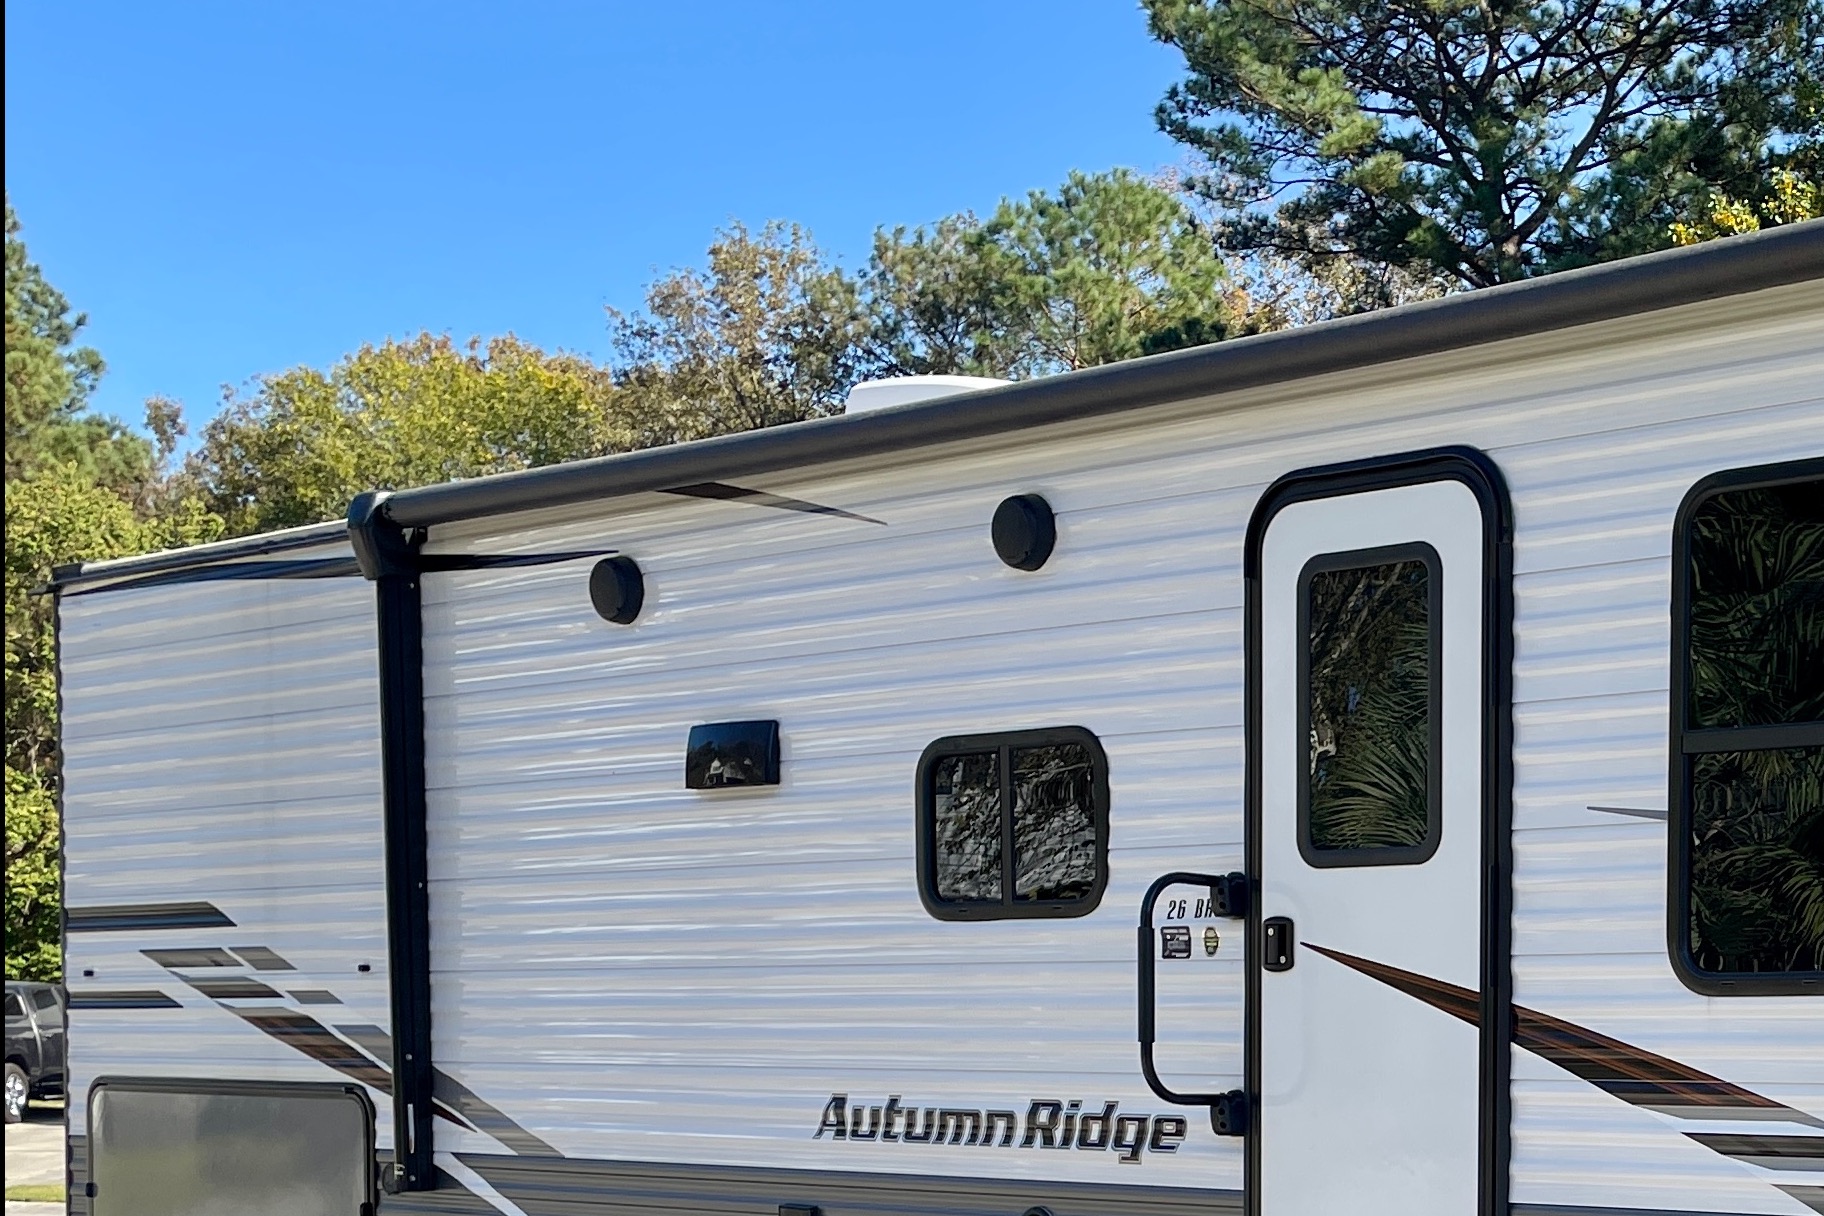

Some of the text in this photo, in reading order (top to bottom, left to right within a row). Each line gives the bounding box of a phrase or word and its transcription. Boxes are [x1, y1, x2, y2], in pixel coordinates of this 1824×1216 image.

[1166, 899, 1187, 920] 26
[812, 1092, 1188, 1165] Autumn Ridge
